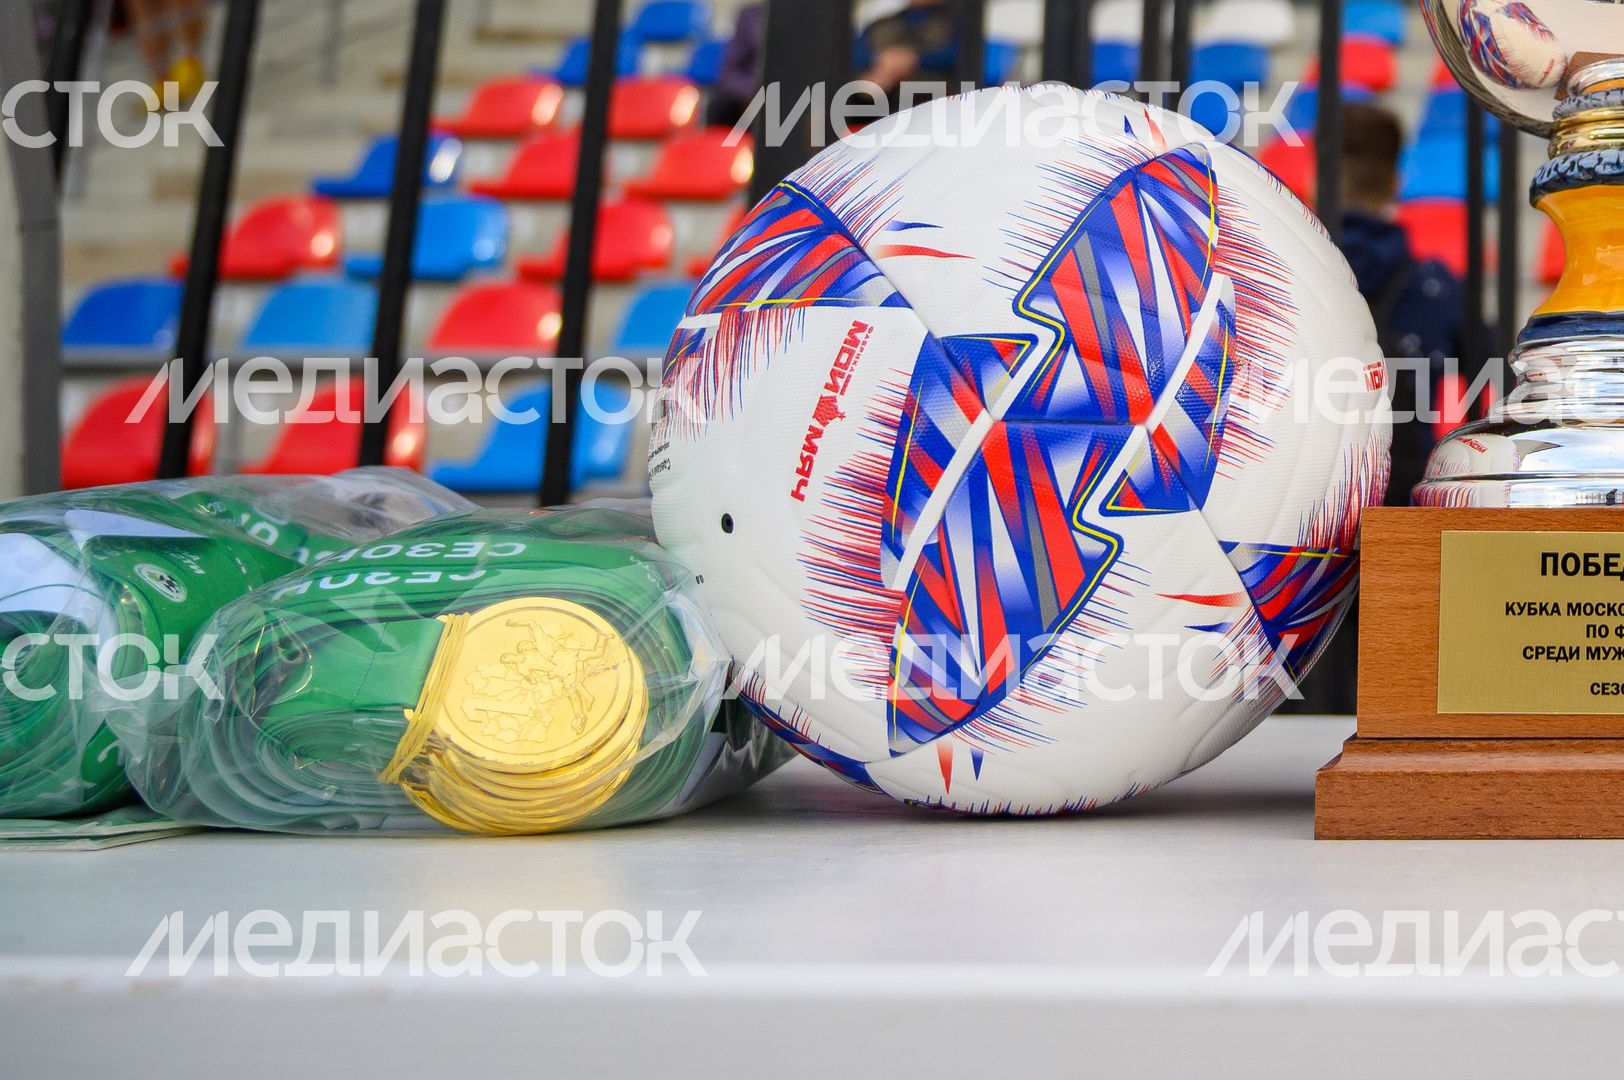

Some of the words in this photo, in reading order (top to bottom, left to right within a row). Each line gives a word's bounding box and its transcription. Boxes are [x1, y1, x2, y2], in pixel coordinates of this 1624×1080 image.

[823, 320, 871, 396] МОЙ
[790, 424, 824, 502] МЯЧ
[1505, 601, 1562, 618] КУБКА
[1585, 623, 1610, 639] ПО
[1522, 645, 1581, 663] СРЕДИ
